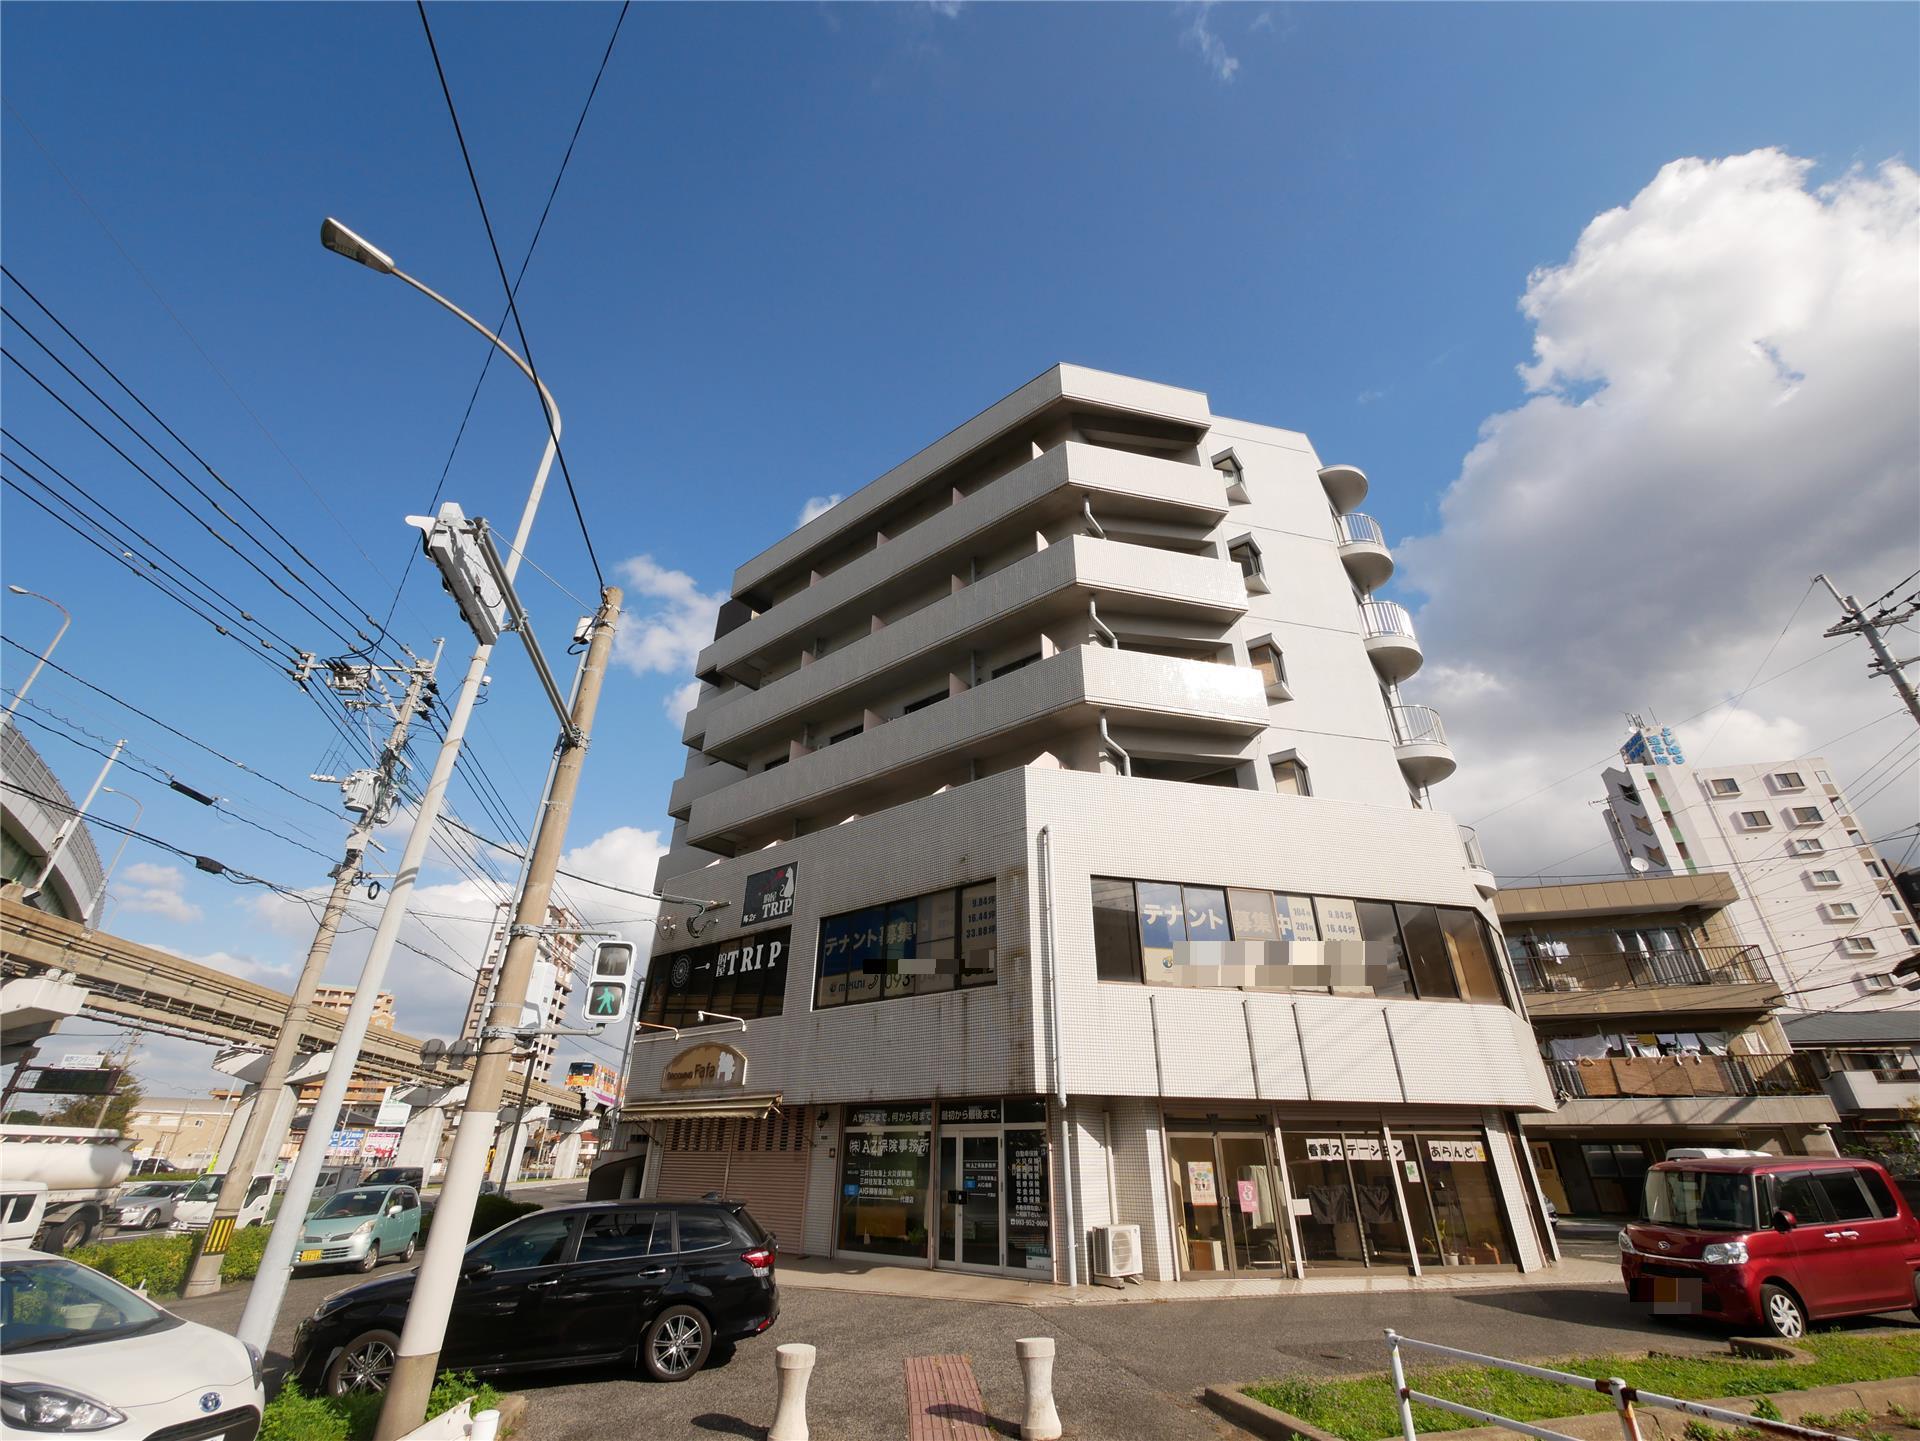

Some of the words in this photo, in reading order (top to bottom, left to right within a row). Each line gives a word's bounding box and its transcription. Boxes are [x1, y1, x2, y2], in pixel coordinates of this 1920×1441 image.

[762, 898, 792, 919] TRIP
[727, 941, 782, 976] TRIP
[694, 1062, 716, 1079] Fafa
[1308, 1143, 1403, 1157] 看護ステーション
